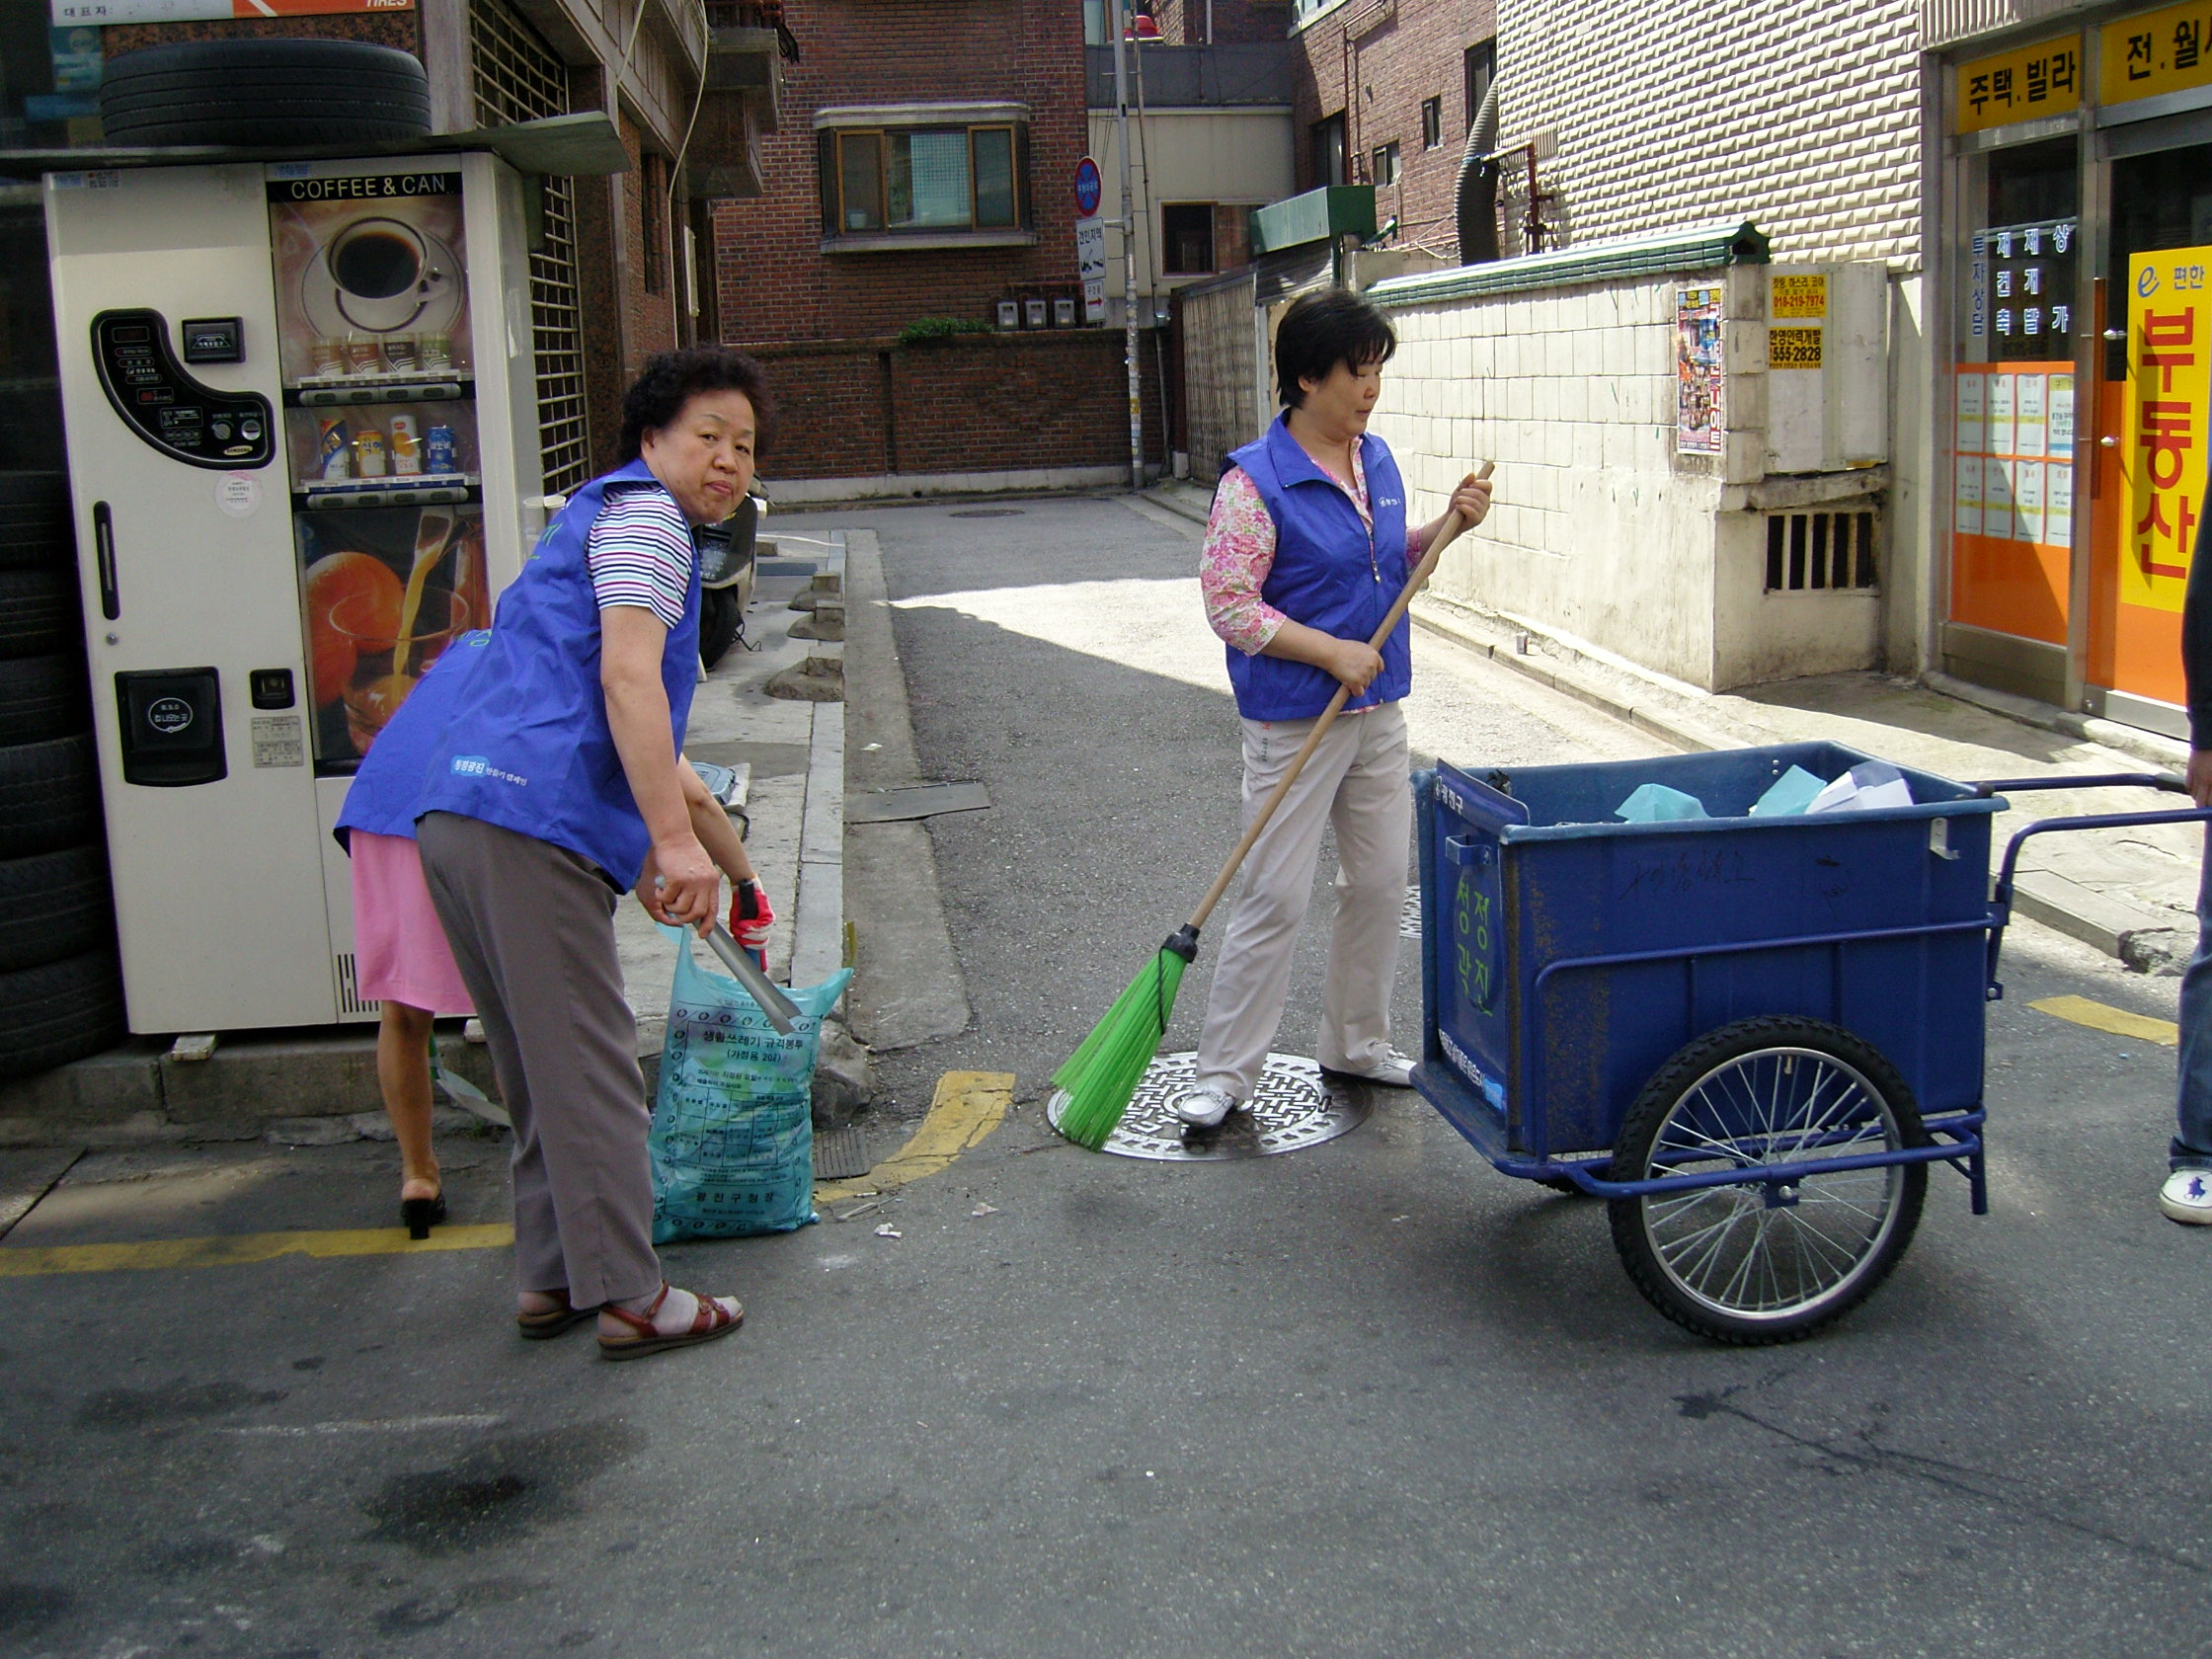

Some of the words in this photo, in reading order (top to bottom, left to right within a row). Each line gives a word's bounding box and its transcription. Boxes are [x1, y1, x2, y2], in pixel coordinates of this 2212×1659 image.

[2126, 15, 2212, 82] 전.월
[1969, 51, 2076, 116] 주택.빌라
[291, 178, 377, 199] COFFEE
[383, 177, 396, 196] &
[1078, 227, 1102, 245] 견인지역
[1972, 236, 1985, 336] 투자상담
[1997, 232, 2011, 336] 재건축
[2024, 228, 2040, 335] 재개발
[2052, 224, 2069, 333] 상가
[2173, 265, 2205, 290] 편한
[1774, 295, 1824, 308] 018-219-7974
[1773, 346, 1821, 362] 555-2828
[2137, 306, 2195, 581] 부동산
[702, 1029, 761, 1049] 생활쓰레기
[764, 1037, 805, 1051] 규격봉투
[727, 1049, 759, 1063] (가정용
